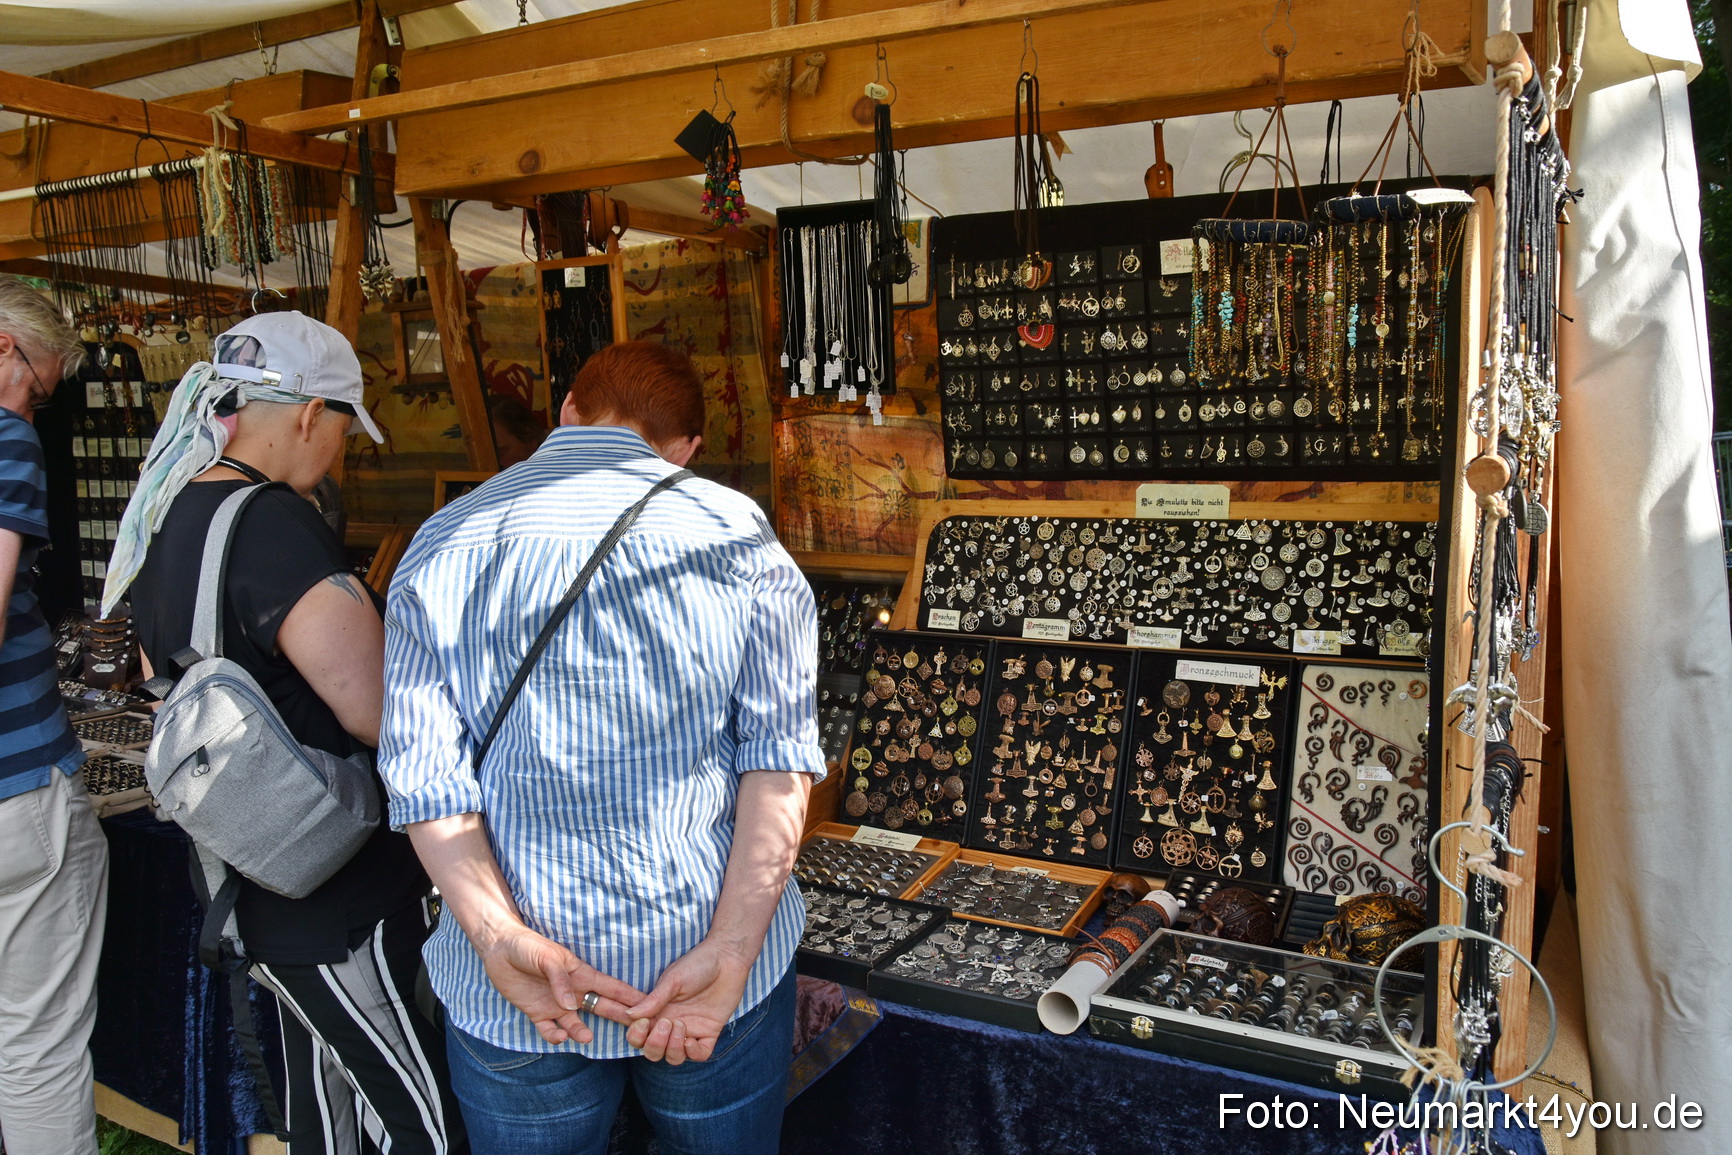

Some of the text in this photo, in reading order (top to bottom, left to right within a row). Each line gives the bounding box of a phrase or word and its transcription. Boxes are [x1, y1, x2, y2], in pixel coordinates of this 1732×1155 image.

[1141, 497, 1224, 507] Die Amulette bitte nicht
[1180, 663, 1255, 680] Bronzeschmuck
